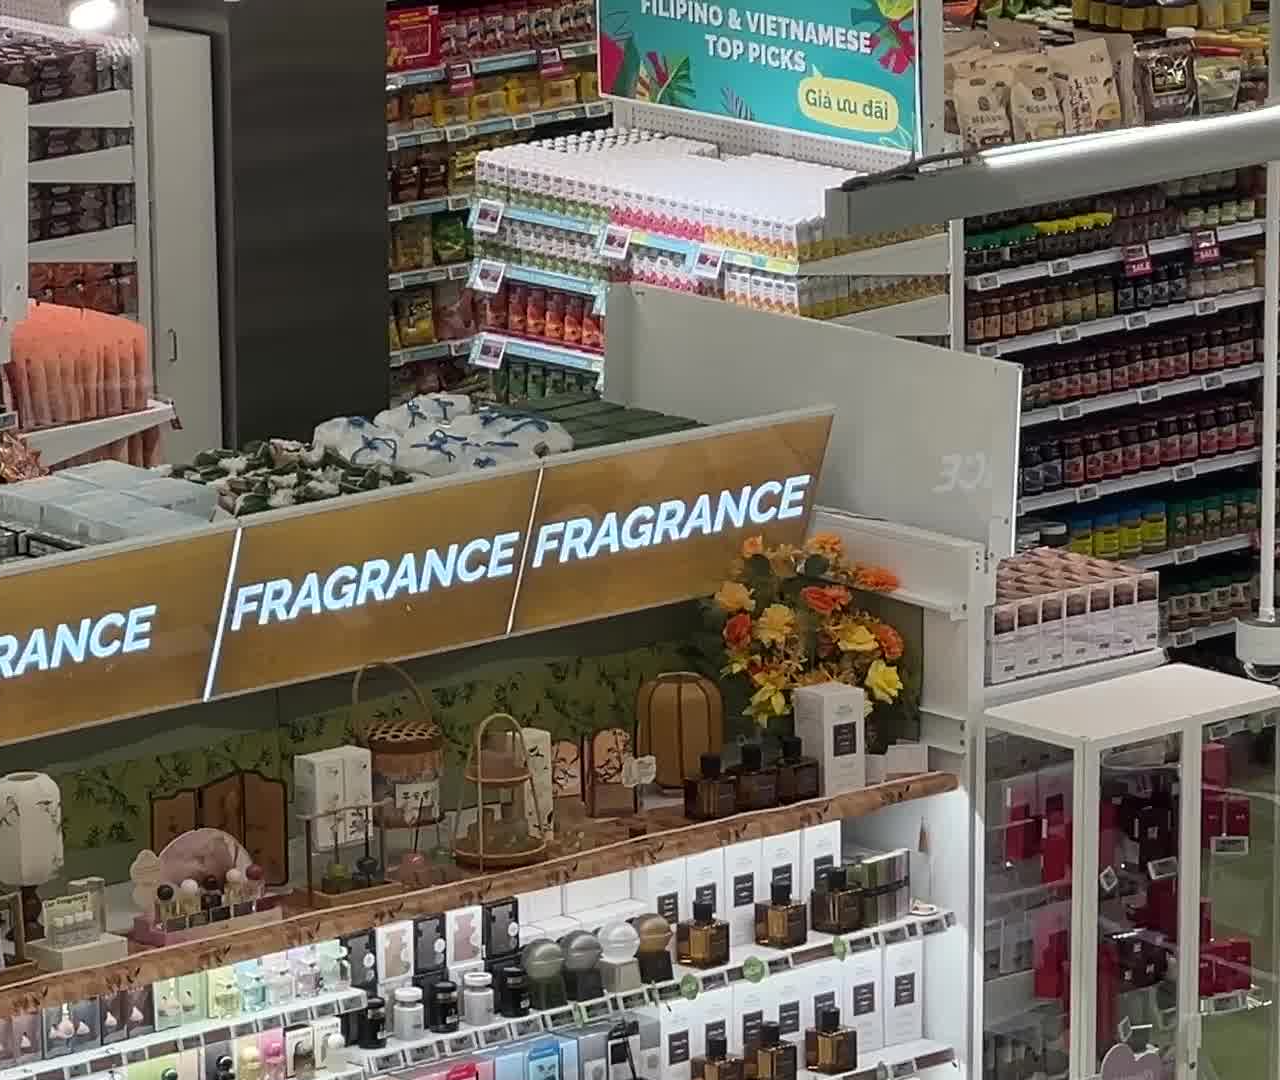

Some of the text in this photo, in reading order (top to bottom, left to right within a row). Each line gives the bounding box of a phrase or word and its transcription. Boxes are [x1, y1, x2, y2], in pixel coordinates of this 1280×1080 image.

[640, 0, 873, 54] FILIPINO & VIETNAMESE
[705, 34, 807, 73] TOP PICKS
[532, 474, 811, 568] FRAGRANCE
[230, 531, 521, 630] FRAGRANCE
